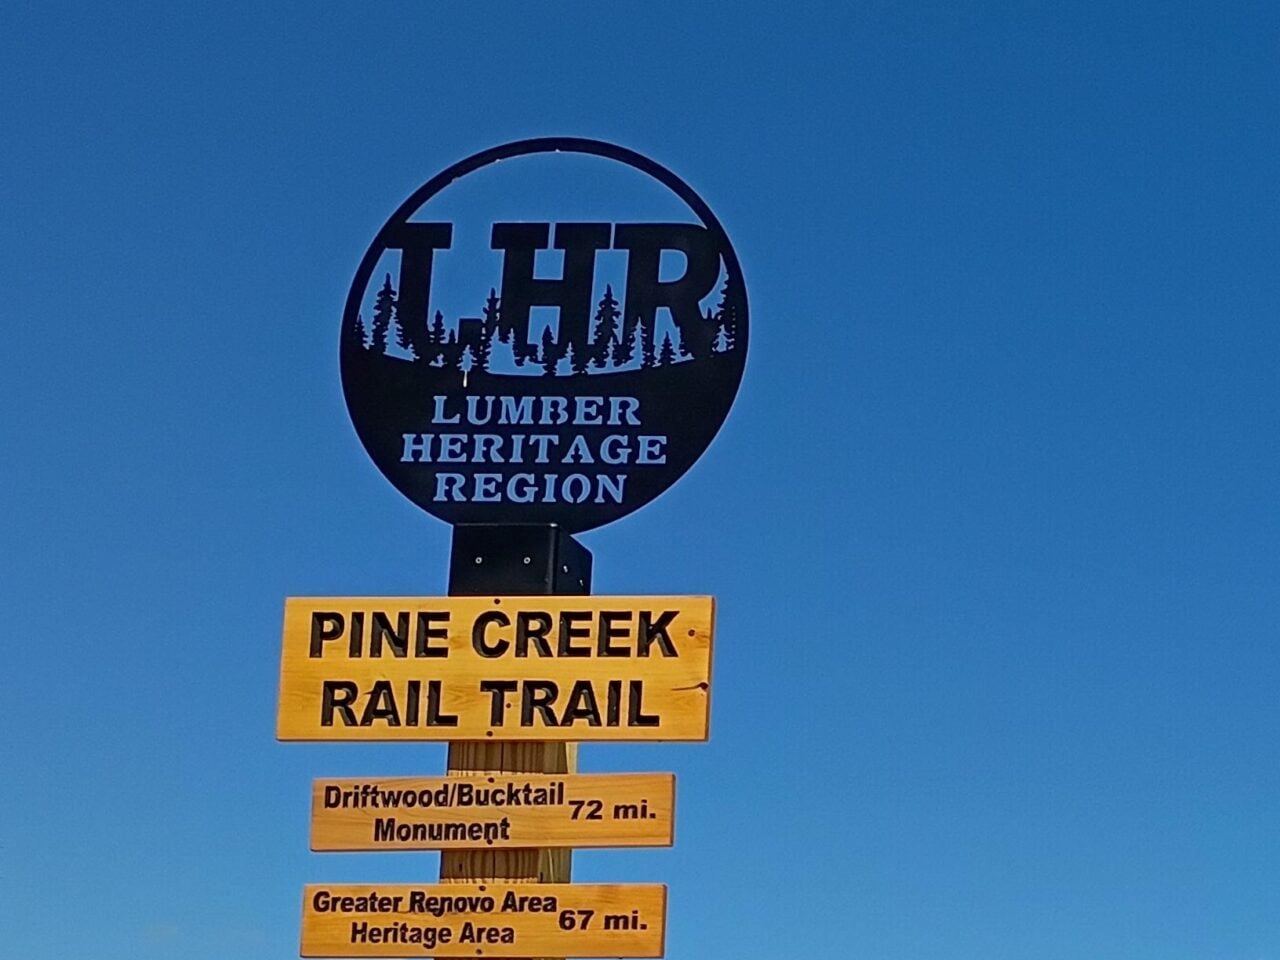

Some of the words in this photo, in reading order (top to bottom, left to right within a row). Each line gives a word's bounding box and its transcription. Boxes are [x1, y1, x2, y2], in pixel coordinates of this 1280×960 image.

[386, 222, 721, 368] LHR
[431, 395, 641, 425] LUMBER
[400, 433, 667, 464] HERITAGE
[433, 472, 628, 503] REGION
[309, 611, 451, 658] PINE
[472, 610, 680, 658] CREEK
[321, 680, 458, 727] RAIL
[480, 680, 660, 727] TRAIL
[324, 782, 564, 809] Driftwood/Bucktail
[568, 800, 603, 821] 72
[613, 799, 657, 820] mi.
[374, 818, 511, 842] Monument
[313, 891, 403, 913] Greater
[409, 891, 494, 916] Renovo
[501, 891, 558, 912] Area
[559, 910, 595, 930] 67
[603, 910, 647, 930] mi.
[351, 922, 452, 949] Heritage
[459, 922, 515, 943] Area
